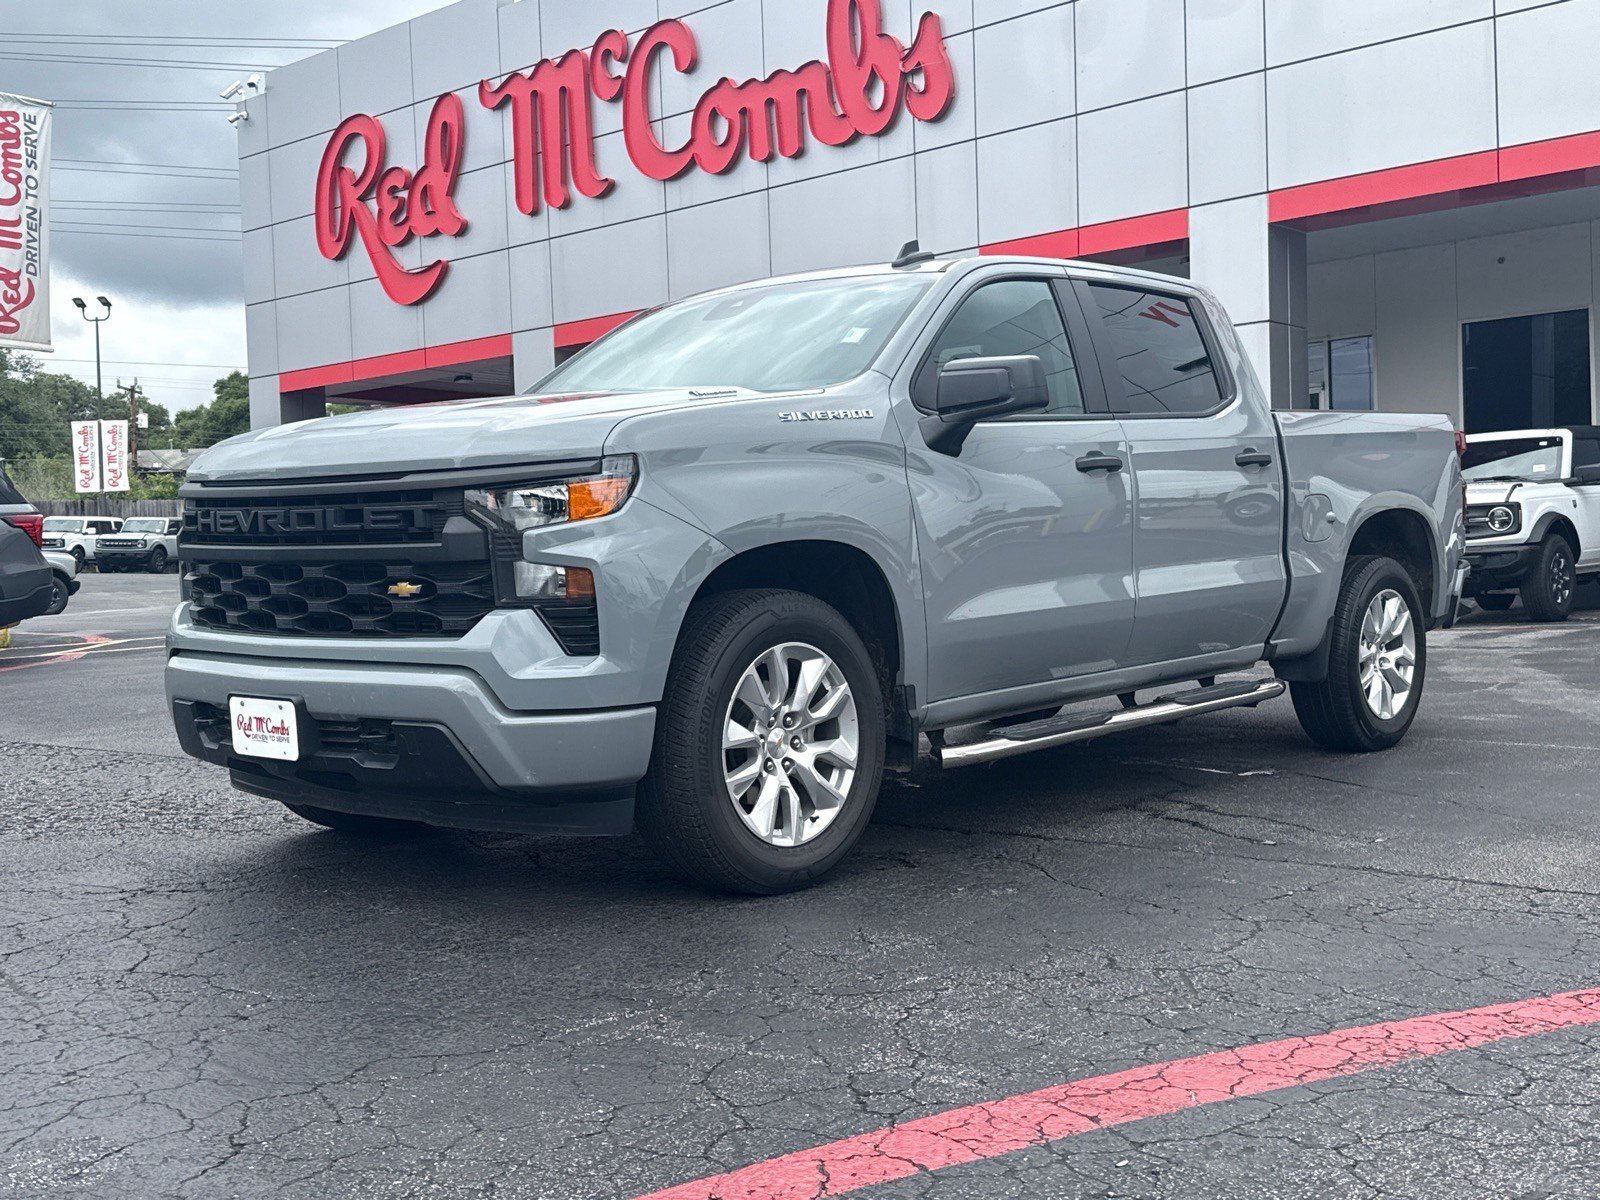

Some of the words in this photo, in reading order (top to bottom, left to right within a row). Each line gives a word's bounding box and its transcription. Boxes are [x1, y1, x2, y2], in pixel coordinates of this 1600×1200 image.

[23, 112, 37, 171] SERVE
[315, 112, 468, 305] Red
[478, 0, 955, 215] McCombs
[25, 175, 38, 200] TO
[25, 206, 38, 277] DRIVEN
[778, 408, 874, 422] SILVERADO
[80, 469, 94, 488] Red
[108, 468, 122, 487] Red
[183, 502, 447, 533] CHEVROLET
[237, 713, 253, 738] Red
[253, 716, 290, 736] McCombs
[252, 733, 268, 741] DRIVEN
[276, 735, 290, 743] SERVE
[697, 686, 718, 797] BRIDGESTONE
